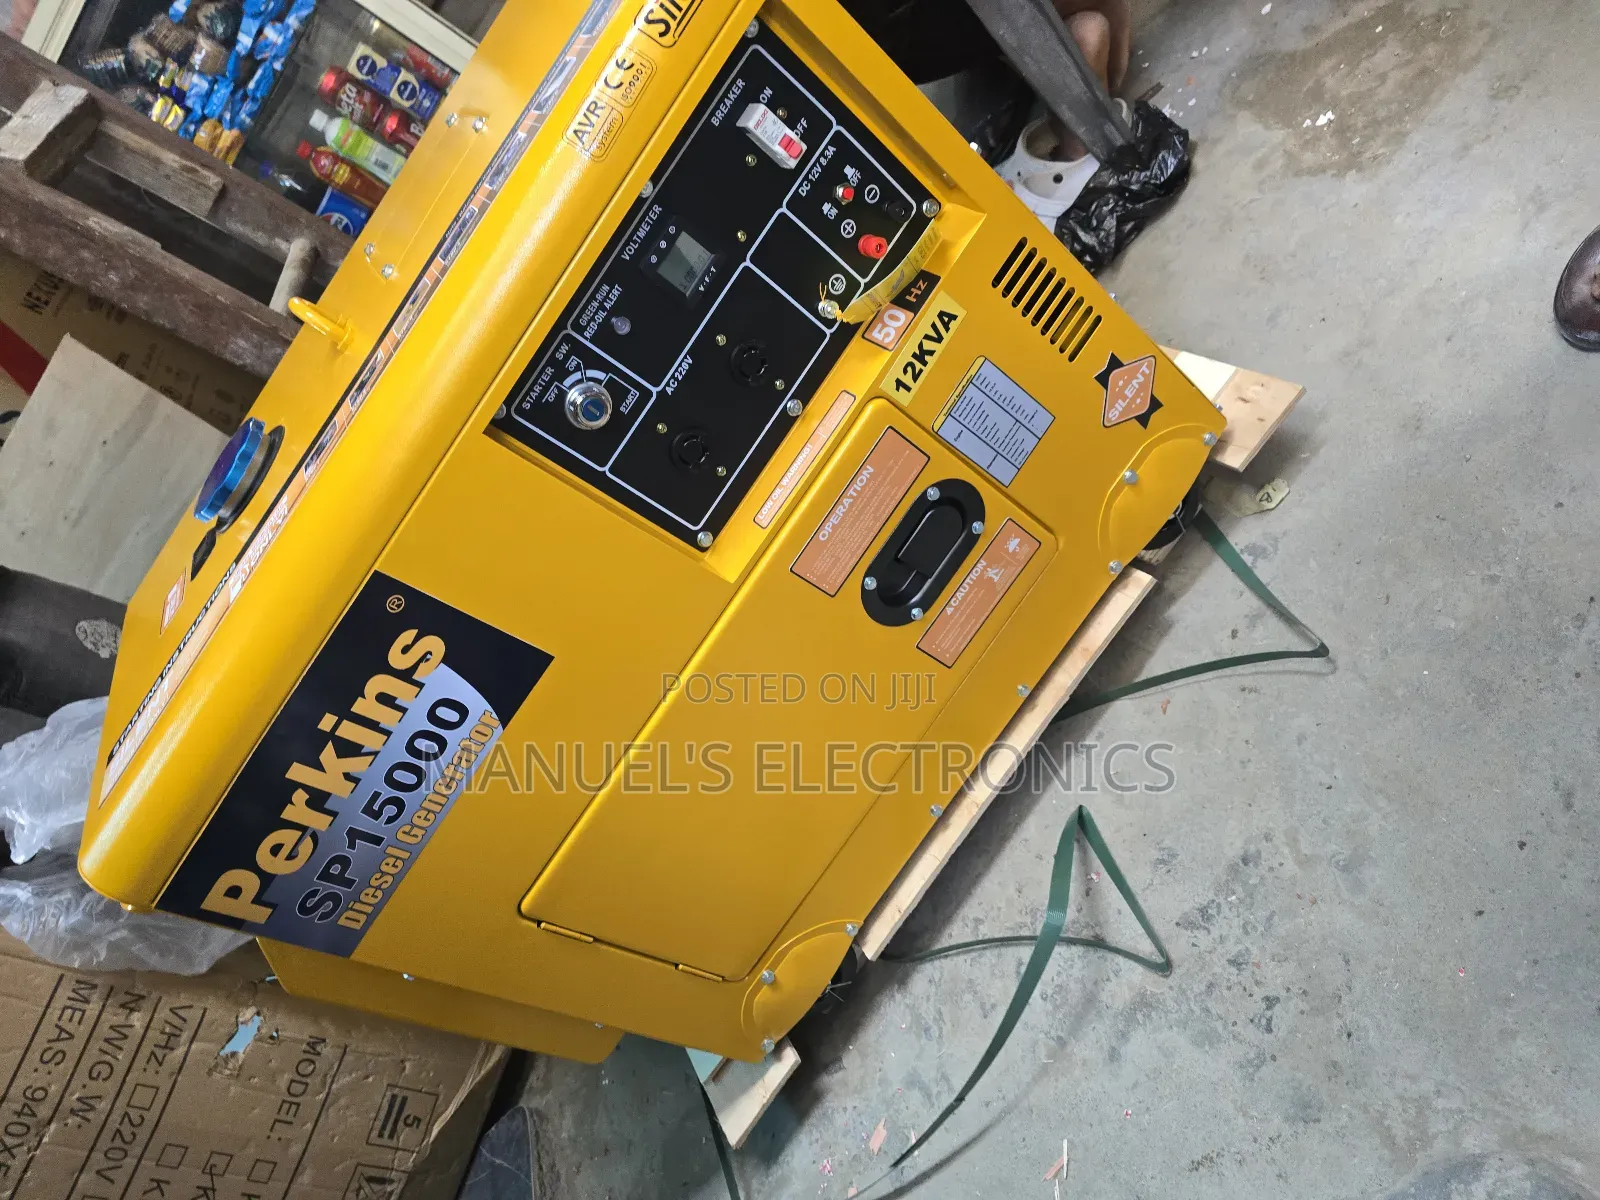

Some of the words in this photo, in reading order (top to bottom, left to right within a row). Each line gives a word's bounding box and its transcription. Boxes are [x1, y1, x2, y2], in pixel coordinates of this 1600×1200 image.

[710, 78, 747, 126] BREAKER
[758, 86, 774, 104] ON
[573, 100, 604, 145] AVR
[792, 117, 810, 138] OFF
[797, 180, 812, 196] DC
[807, 162, 824, 182] 12V
[818, 144, 836, 166] 8.3A
[848, 169, 863, 187] OFF
[619, 202, 664, 261] VOLTMETER
[826, 206, 838, 220] ON
[578, 282, 612, 326] GREEN-RUN
[582, 306, 608, 338] RED-OIL
[602, 283, 624, 310] ALERT
[872, 309, 908, 345] 50
[906, 277, 928, 303] Hz
[521, 365, 555, 410] STARTER
[554, 340, 571, 360] SW.
[567, 358, 578, 371] ON
[664, 377, 680, 395] AC
[673, 354, 695, 380] 220V
[894, 306, 959, 396] 12KVA
[546, 387, 560, 402] OFF
[619, 390, 637, 412] START
[1108, 362, 1152, 421] SILENT
[757, 499, 774, 519] LOW
[771, 486, 783, 500] OIL
[817, 465, 874, 542] OPERATION
[949, 558, 987, 608] CAUTION
[199, 627, 448, 925] Perkins
[294, 696, 471, 924] SP15000
[336, 846, 412, 931] Diesel
[395, 711, 503, 845] Generator
[266, 1034, 328, 1142] MODEL:
[403, 1113, 422, 1129] 5
[95, 1110, 146, 1186] 220V
